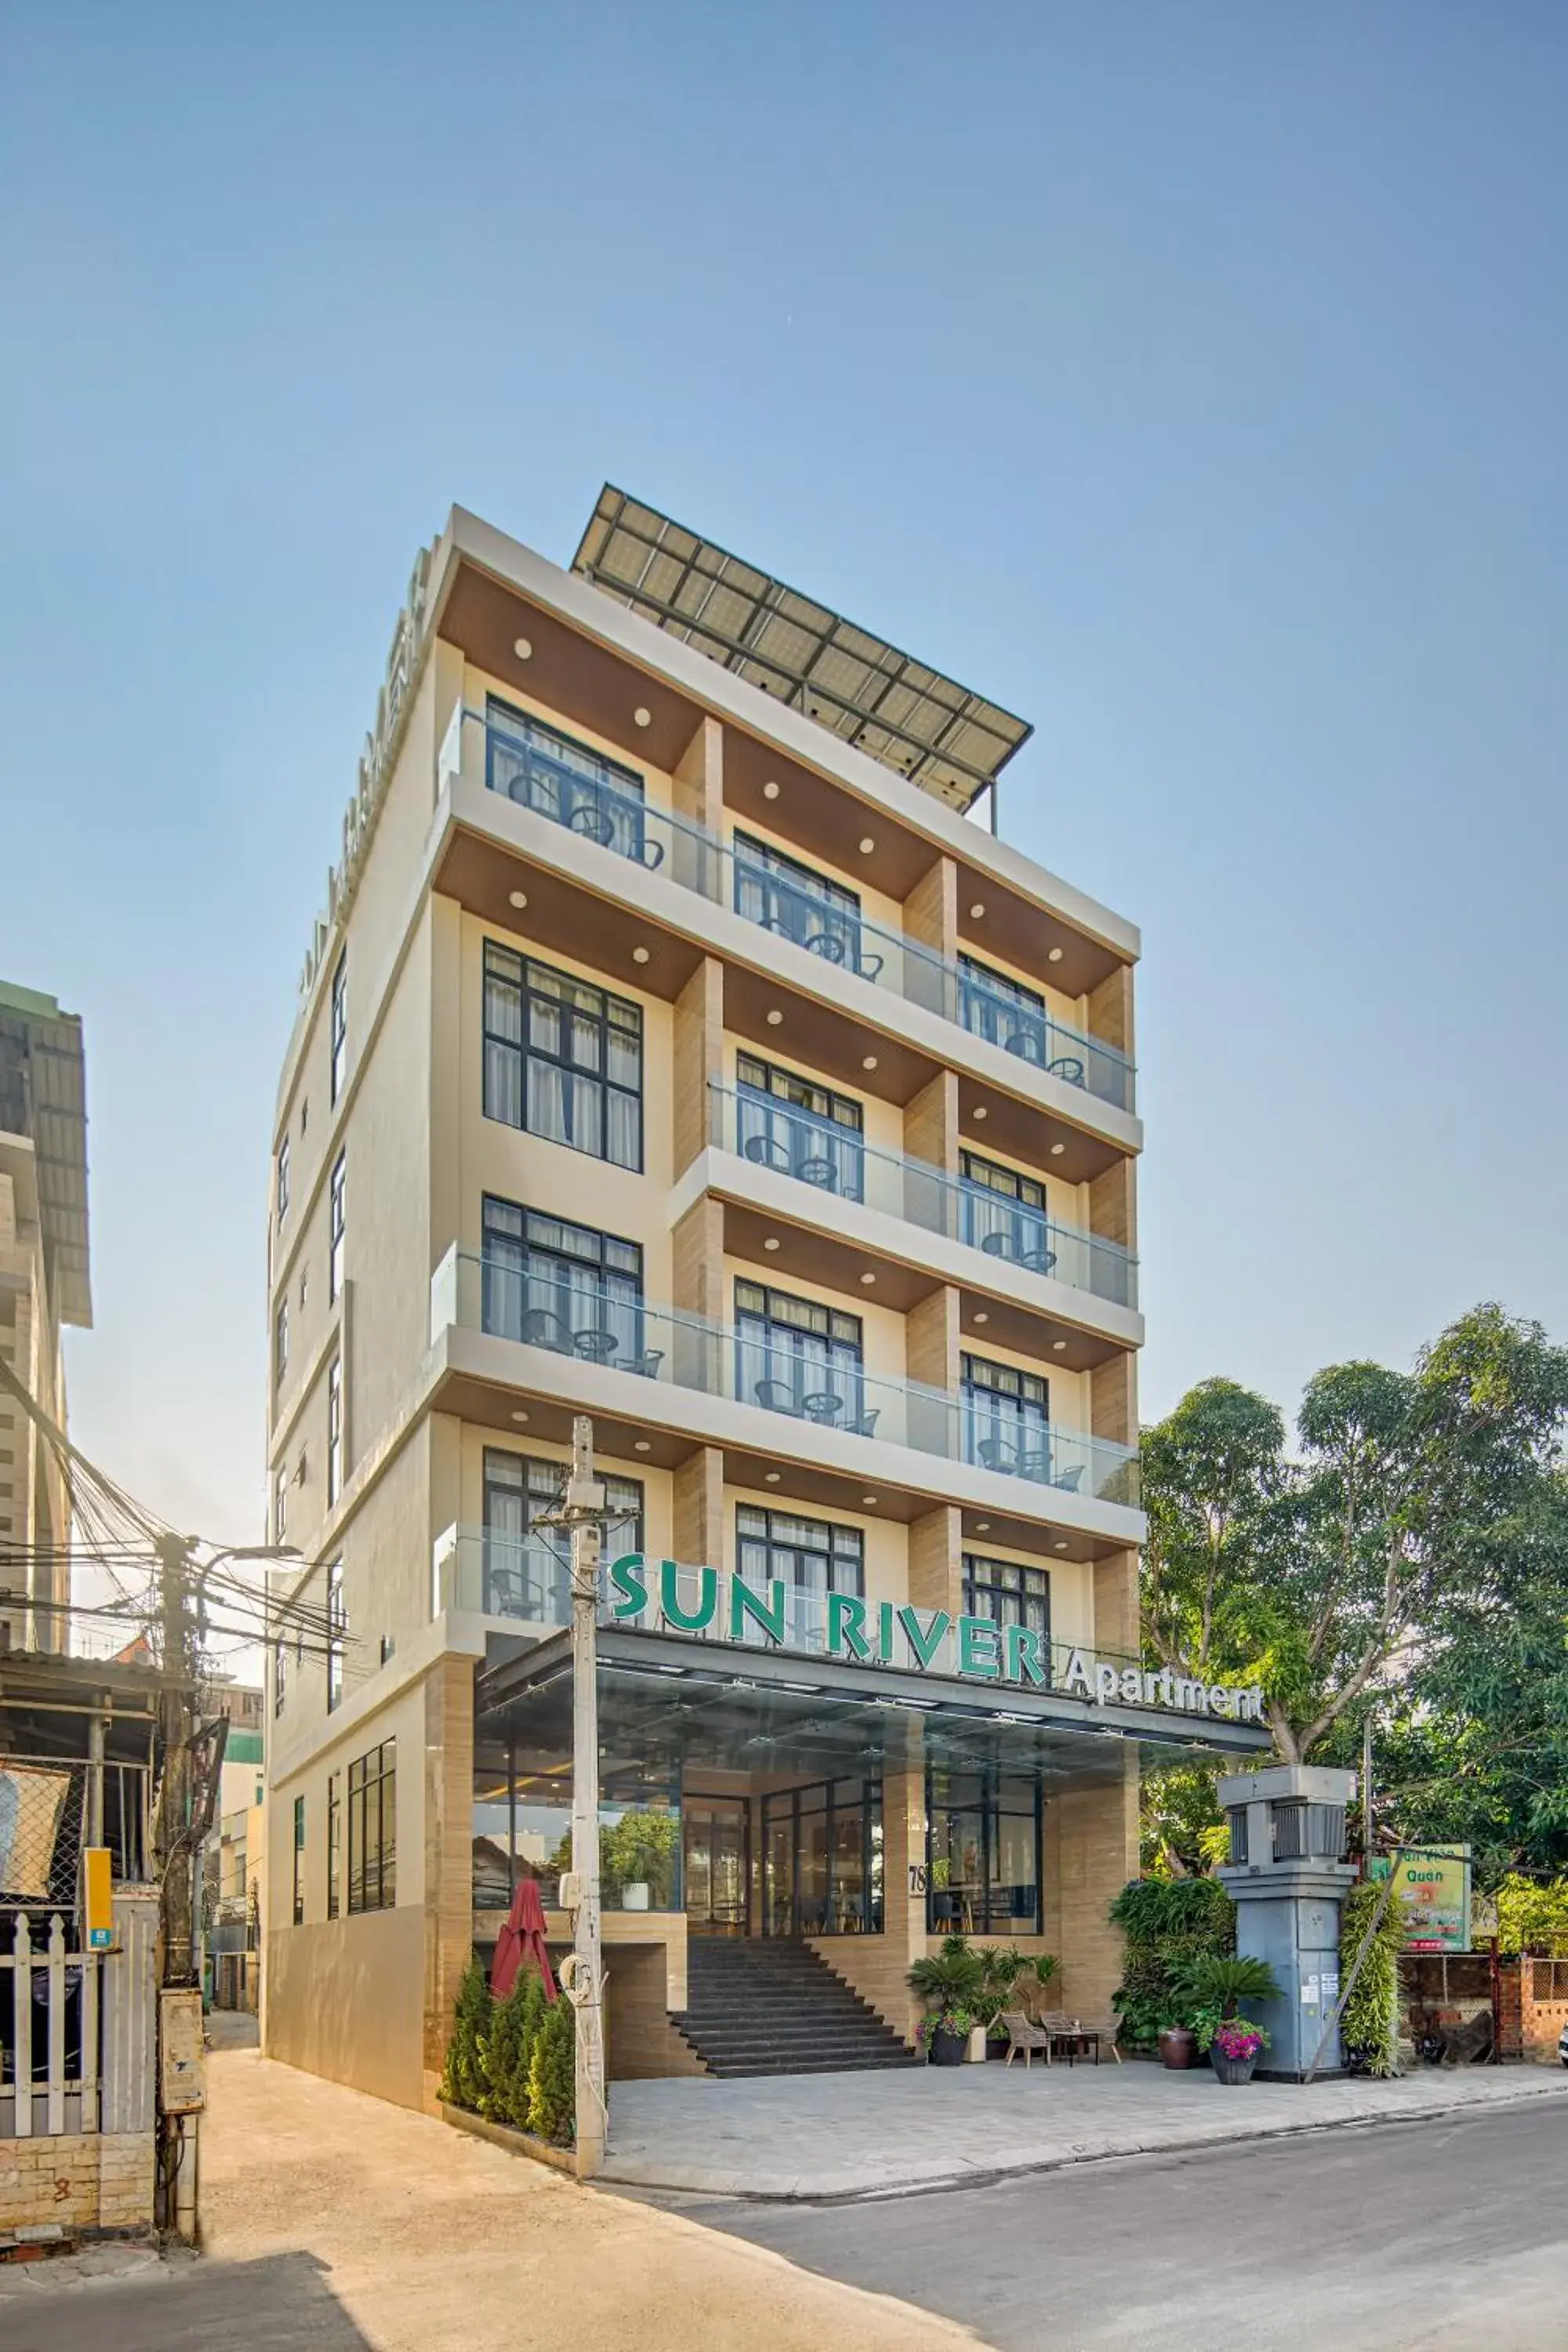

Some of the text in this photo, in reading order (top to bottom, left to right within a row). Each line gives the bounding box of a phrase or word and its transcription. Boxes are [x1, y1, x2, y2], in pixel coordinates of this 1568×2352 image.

[608, 1552, 1265, 1723] SUN RIVER Apartment
[909, 1865, 926, 1892] 78
